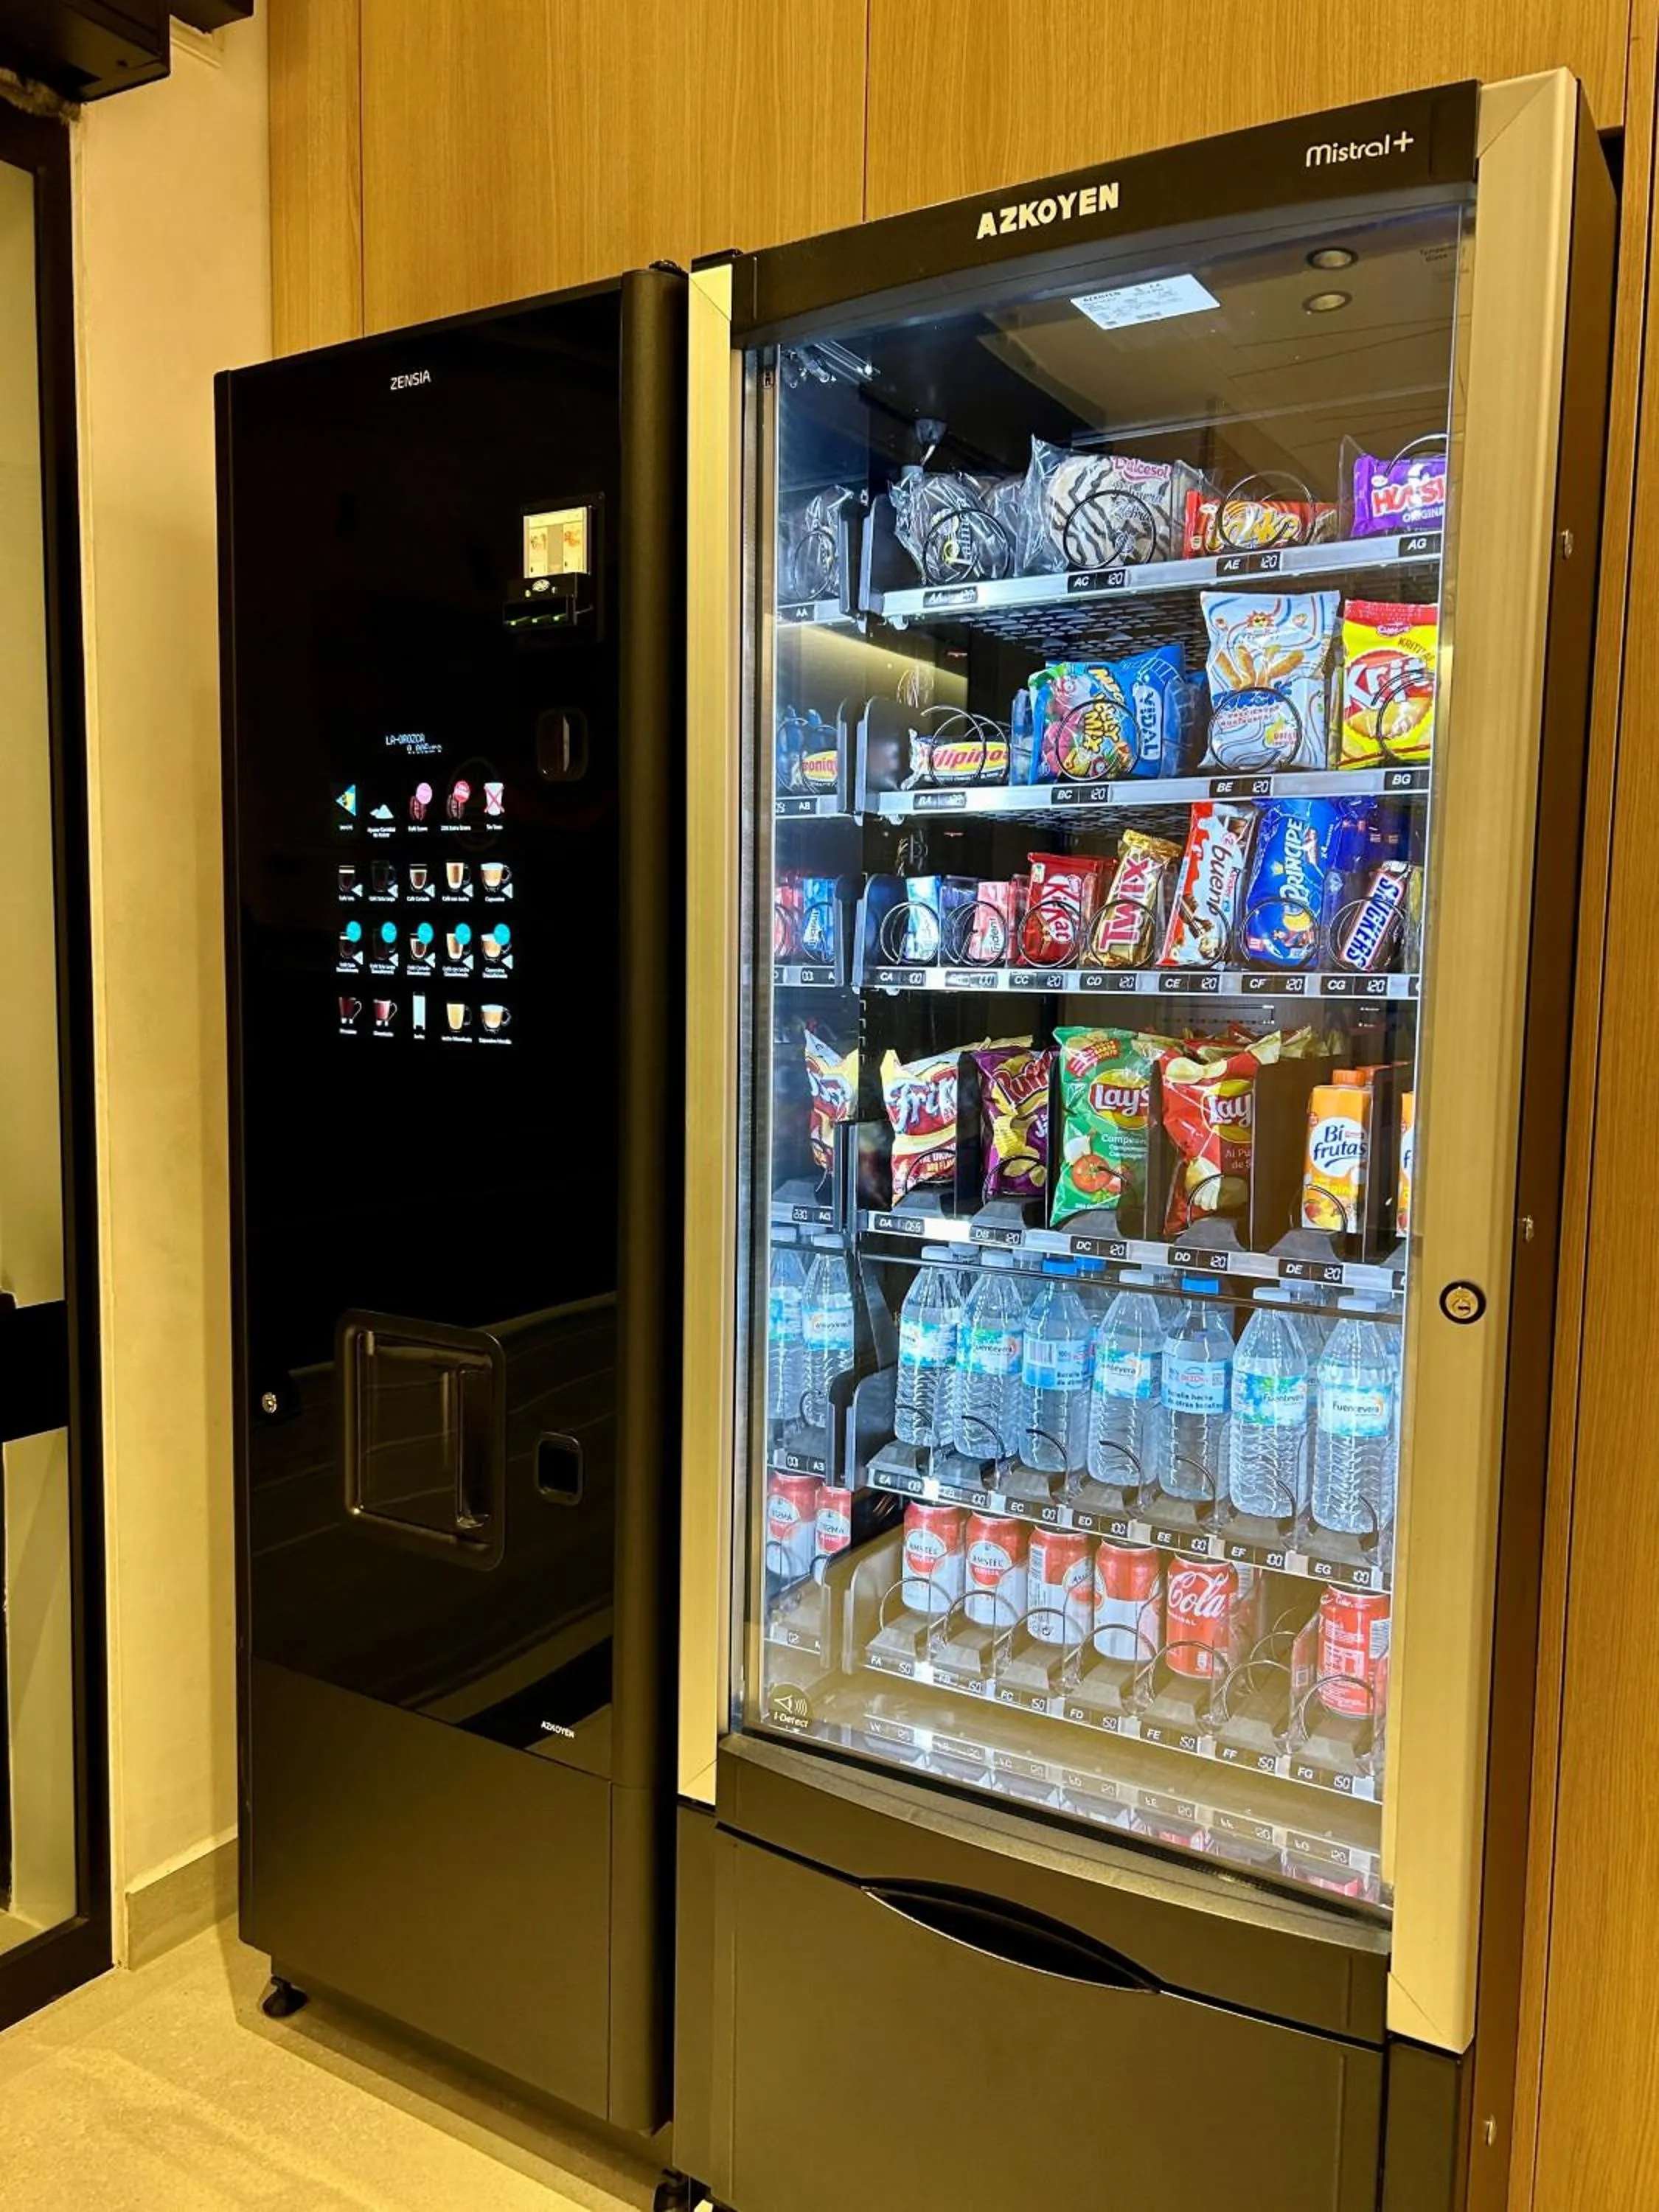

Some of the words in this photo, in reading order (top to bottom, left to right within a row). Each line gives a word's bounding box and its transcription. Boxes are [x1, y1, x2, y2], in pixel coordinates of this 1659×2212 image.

[976, 182, 1119, 240] AZKOYEN
[390, 370, 431, 390] ZENSIA
[1406, 539, 1426, 551] AG
[1223, 559, 1241, 570] AE
[1073, 576, 1089, 587] AC
[1142, 690, 1159, 756] VIDAL
[1392, 773, 1411, 786] BG
[1216, 782, 1234, 793] BE
[1057, 790, 1073, 800] BC
[1099, 857, 1153, 953] TWIX
[1346, 877, 1399, 969] SNICKERS
[880, 973, 893, 982] CA
[1014, 976, 1029, 985] CC
[1086, 976, 1102, 986] CD
[1164, 978, 1182, 989] CE
[1249, 978, 1267, 990] CF
[1327, 979, 1346, 991] CG
[1324, 1124, 1345, 1143] Bi
[1313, 1141, 1367, 1161] frutas
[1076, 1241, 1091, 1251] DC
[1174, 1251, 1191, 1262] DD
[1285, 1263, 1303, 1275] DE
[1010, 1501, 1024, 1513] EC
[1078, 1515, 1093, 1526] ED
[1157, 1531, 1172, 1543] EE
[1231, 1546, 1247, 1558] EF
[972, 1555, 1004, 1567] AMSTEL
[1315, 1562, 1332, 1576] EG
[540, 1720, 574, 1739] AZKOYEN
[1147, 1728, 1162, 1740] FE
[1222, 1748, 1238, 1760] FF
